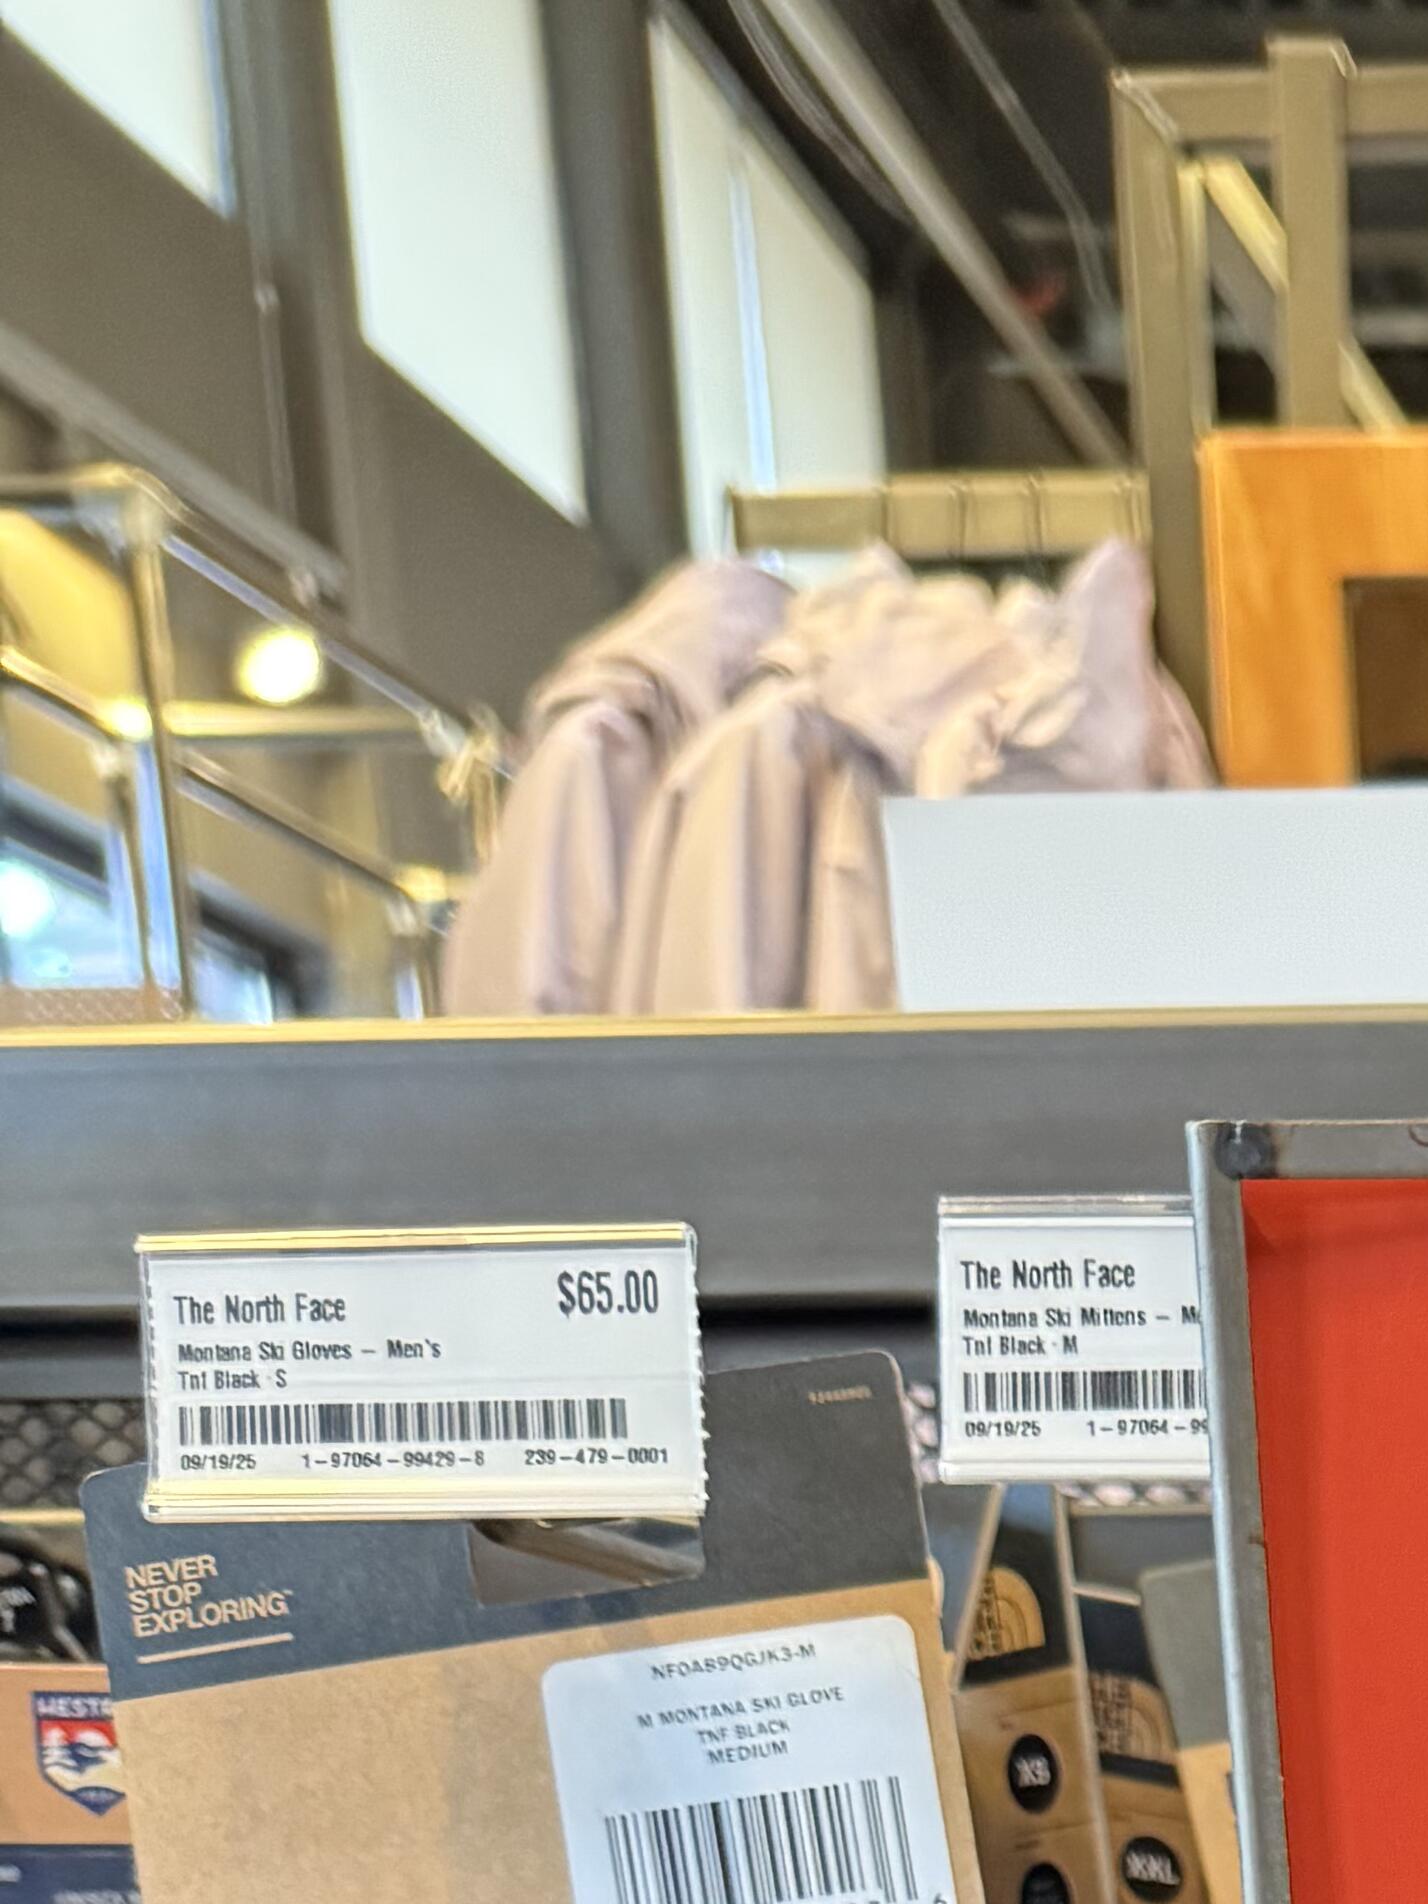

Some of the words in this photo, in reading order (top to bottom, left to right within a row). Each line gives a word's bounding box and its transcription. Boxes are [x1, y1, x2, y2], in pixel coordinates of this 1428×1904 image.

[960, 1260, 1002, 1290] The
[1012, 1259, 1073, 1289] North
[1084, 1258, 1136, 1288] Face
[174, 1296, 215, 1326] The
[225, 1293, 286, 1324] North
[295, 1291, 346, 1323] Face
[557, 1267, 660, 1318] $65.00
[963, 1308, 1038, 1328] Montana
[1045, 1307, 1071, 1327] Ski
[1080, 1306, 1147, 1326] Mittens
[178, 1341, 252, 1364] Montana
[292, 1339, 352, 1361] Gloves
[387, 1338, 441, 1361] Men's
[1000, 1335, 1046, 1355] Black
[214, 1369, 261, 1391] Black
[965, 1419, 1041, 1438] 09/19/25
[180, 1452, 257, 1471] 09/19/25
[124, 1554, 218, 1589] NEVER
[128, 1582, 203, 1615] STOP
[637, 1714, 653, 1729] M
[660, 1699, 746, 1728] MONTANA
[751, 1694, 782, 1714] SKI
[786, 1686, 845, 1710] GLOVE
[696, 1725, 729, 1745] TNF
[734, 1718, 790, 1741] BLACK
[706, 1740, 788, 1764] MEDIUM
